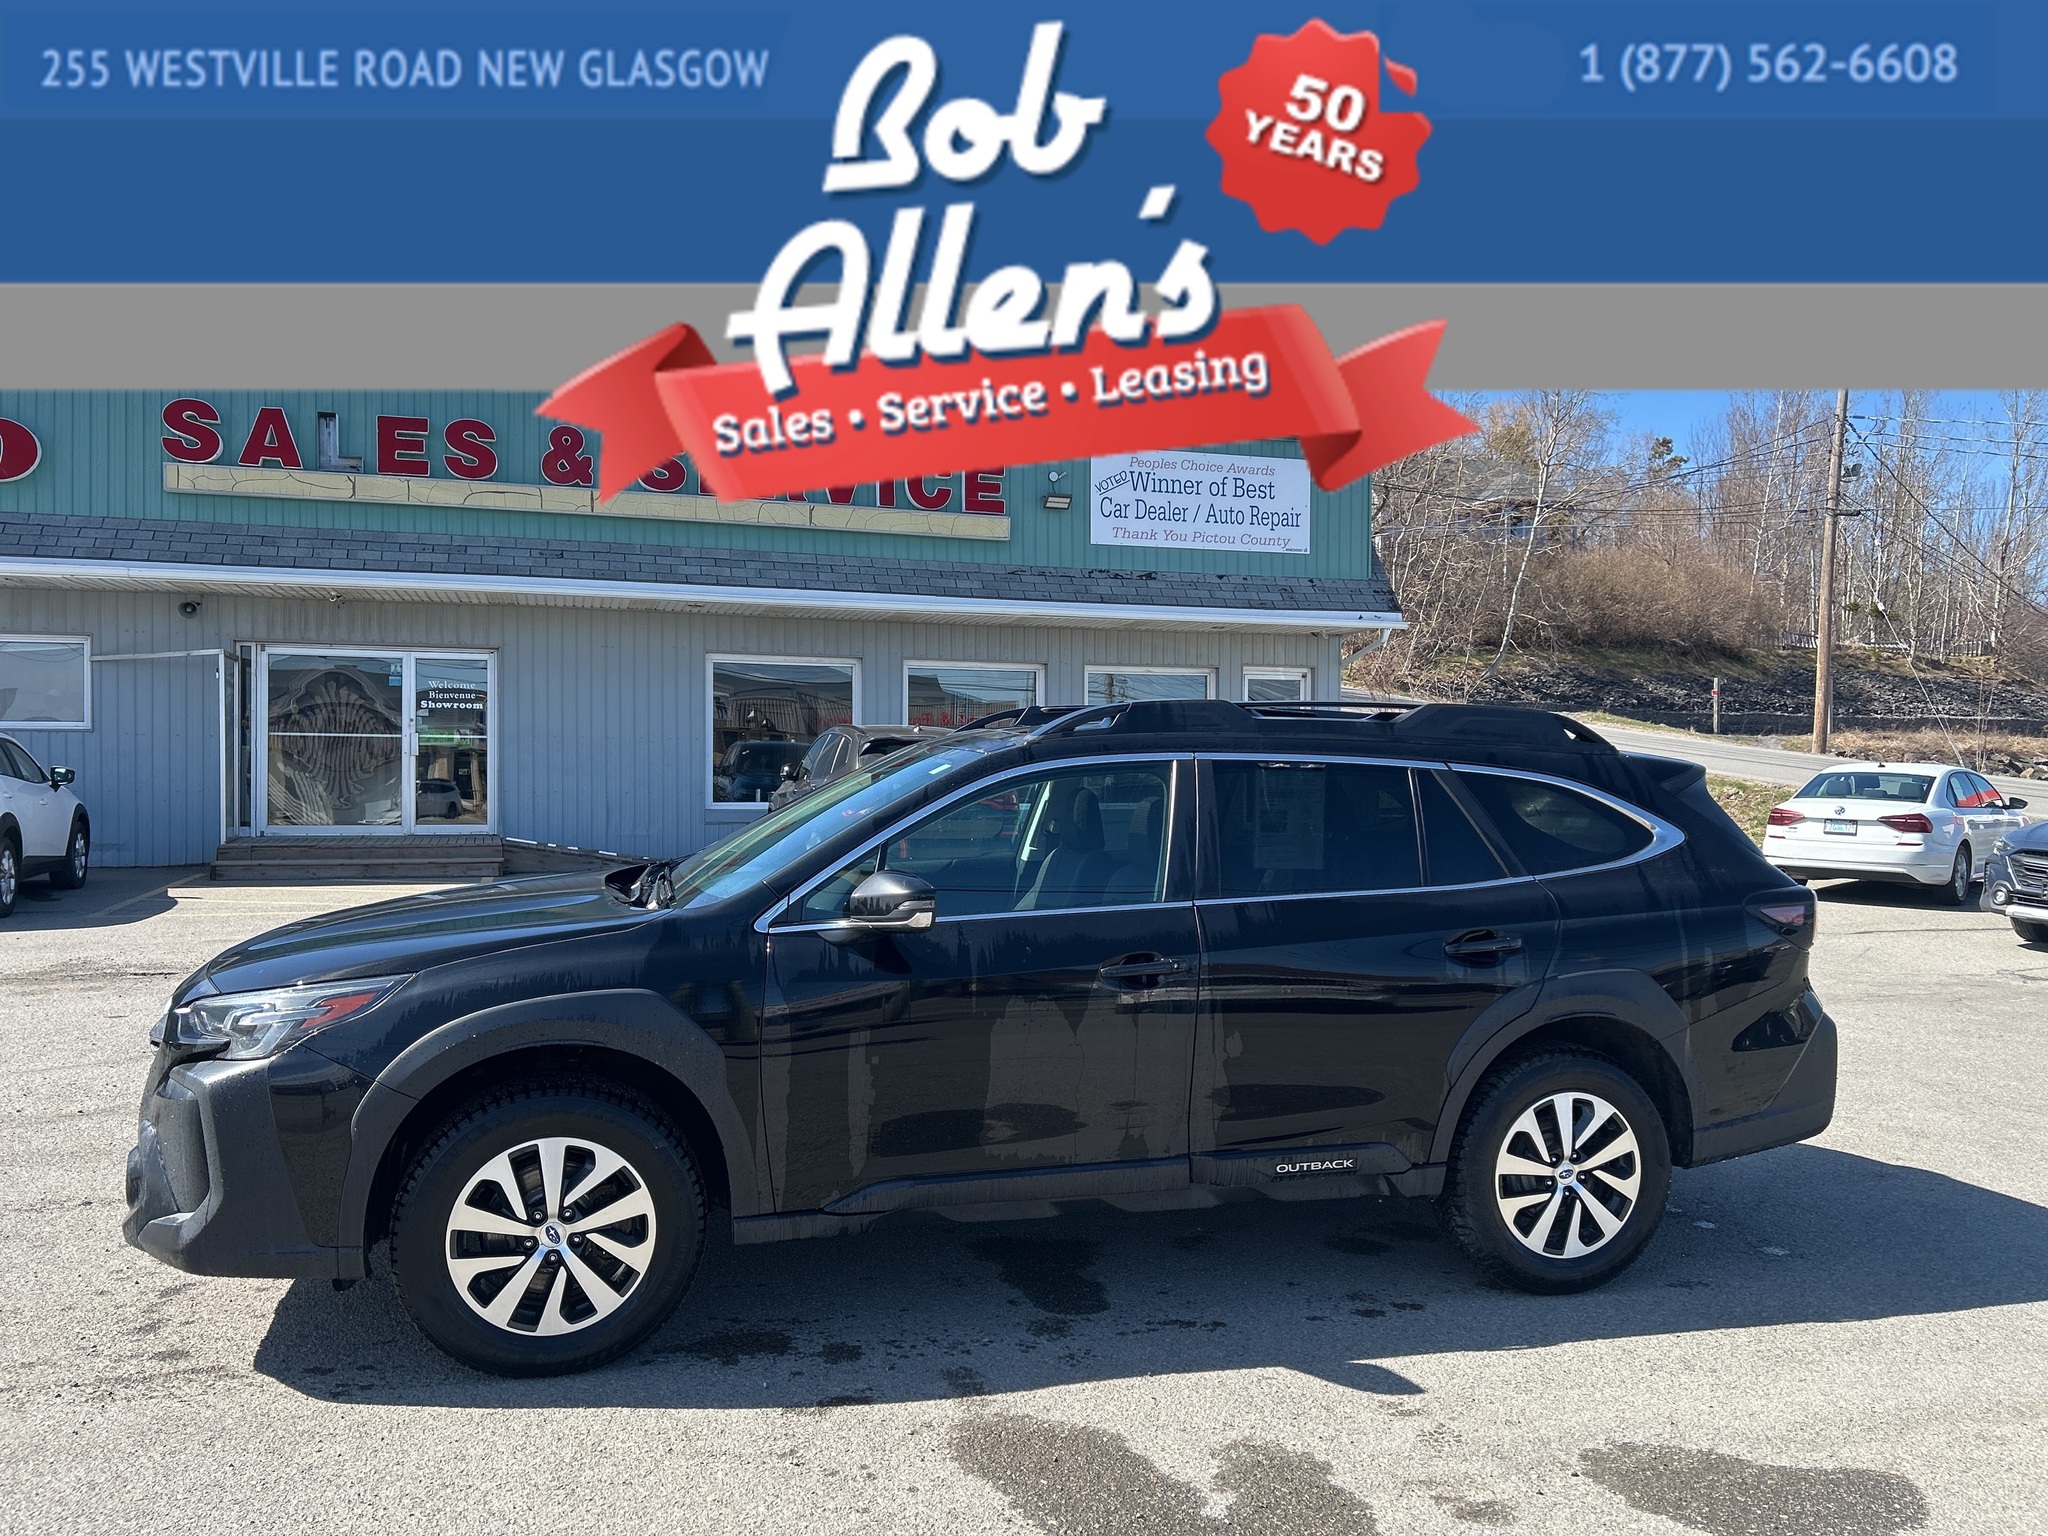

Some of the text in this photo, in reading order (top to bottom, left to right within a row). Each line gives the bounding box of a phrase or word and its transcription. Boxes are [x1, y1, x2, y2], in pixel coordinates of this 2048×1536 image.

[161, 398, 498, 480] SALES
[541, 425, 593, 487] &
[1129, 457, 1276, 476] Peoples Choice Awards
[1095, 470, 1128, 492] VOTED
[1129, 471, 1276, 500] Winner of Best
[1100, 496, 1131, 519] Car
[1134, 499, 1189, 522] Dealer
[1205, 503, 1245, 525] Auto
[1249, 505, 1302, 531] Repair
[1112, 527, 1291, 549] Thank You Pictou County
[428, 681, 476, 689] Welcome
[428, 691, 476, 699] Bienvenue
[420, 700, 484, 710] Showroom
[1276, 1159, 1354, 1173] OUTBACK
